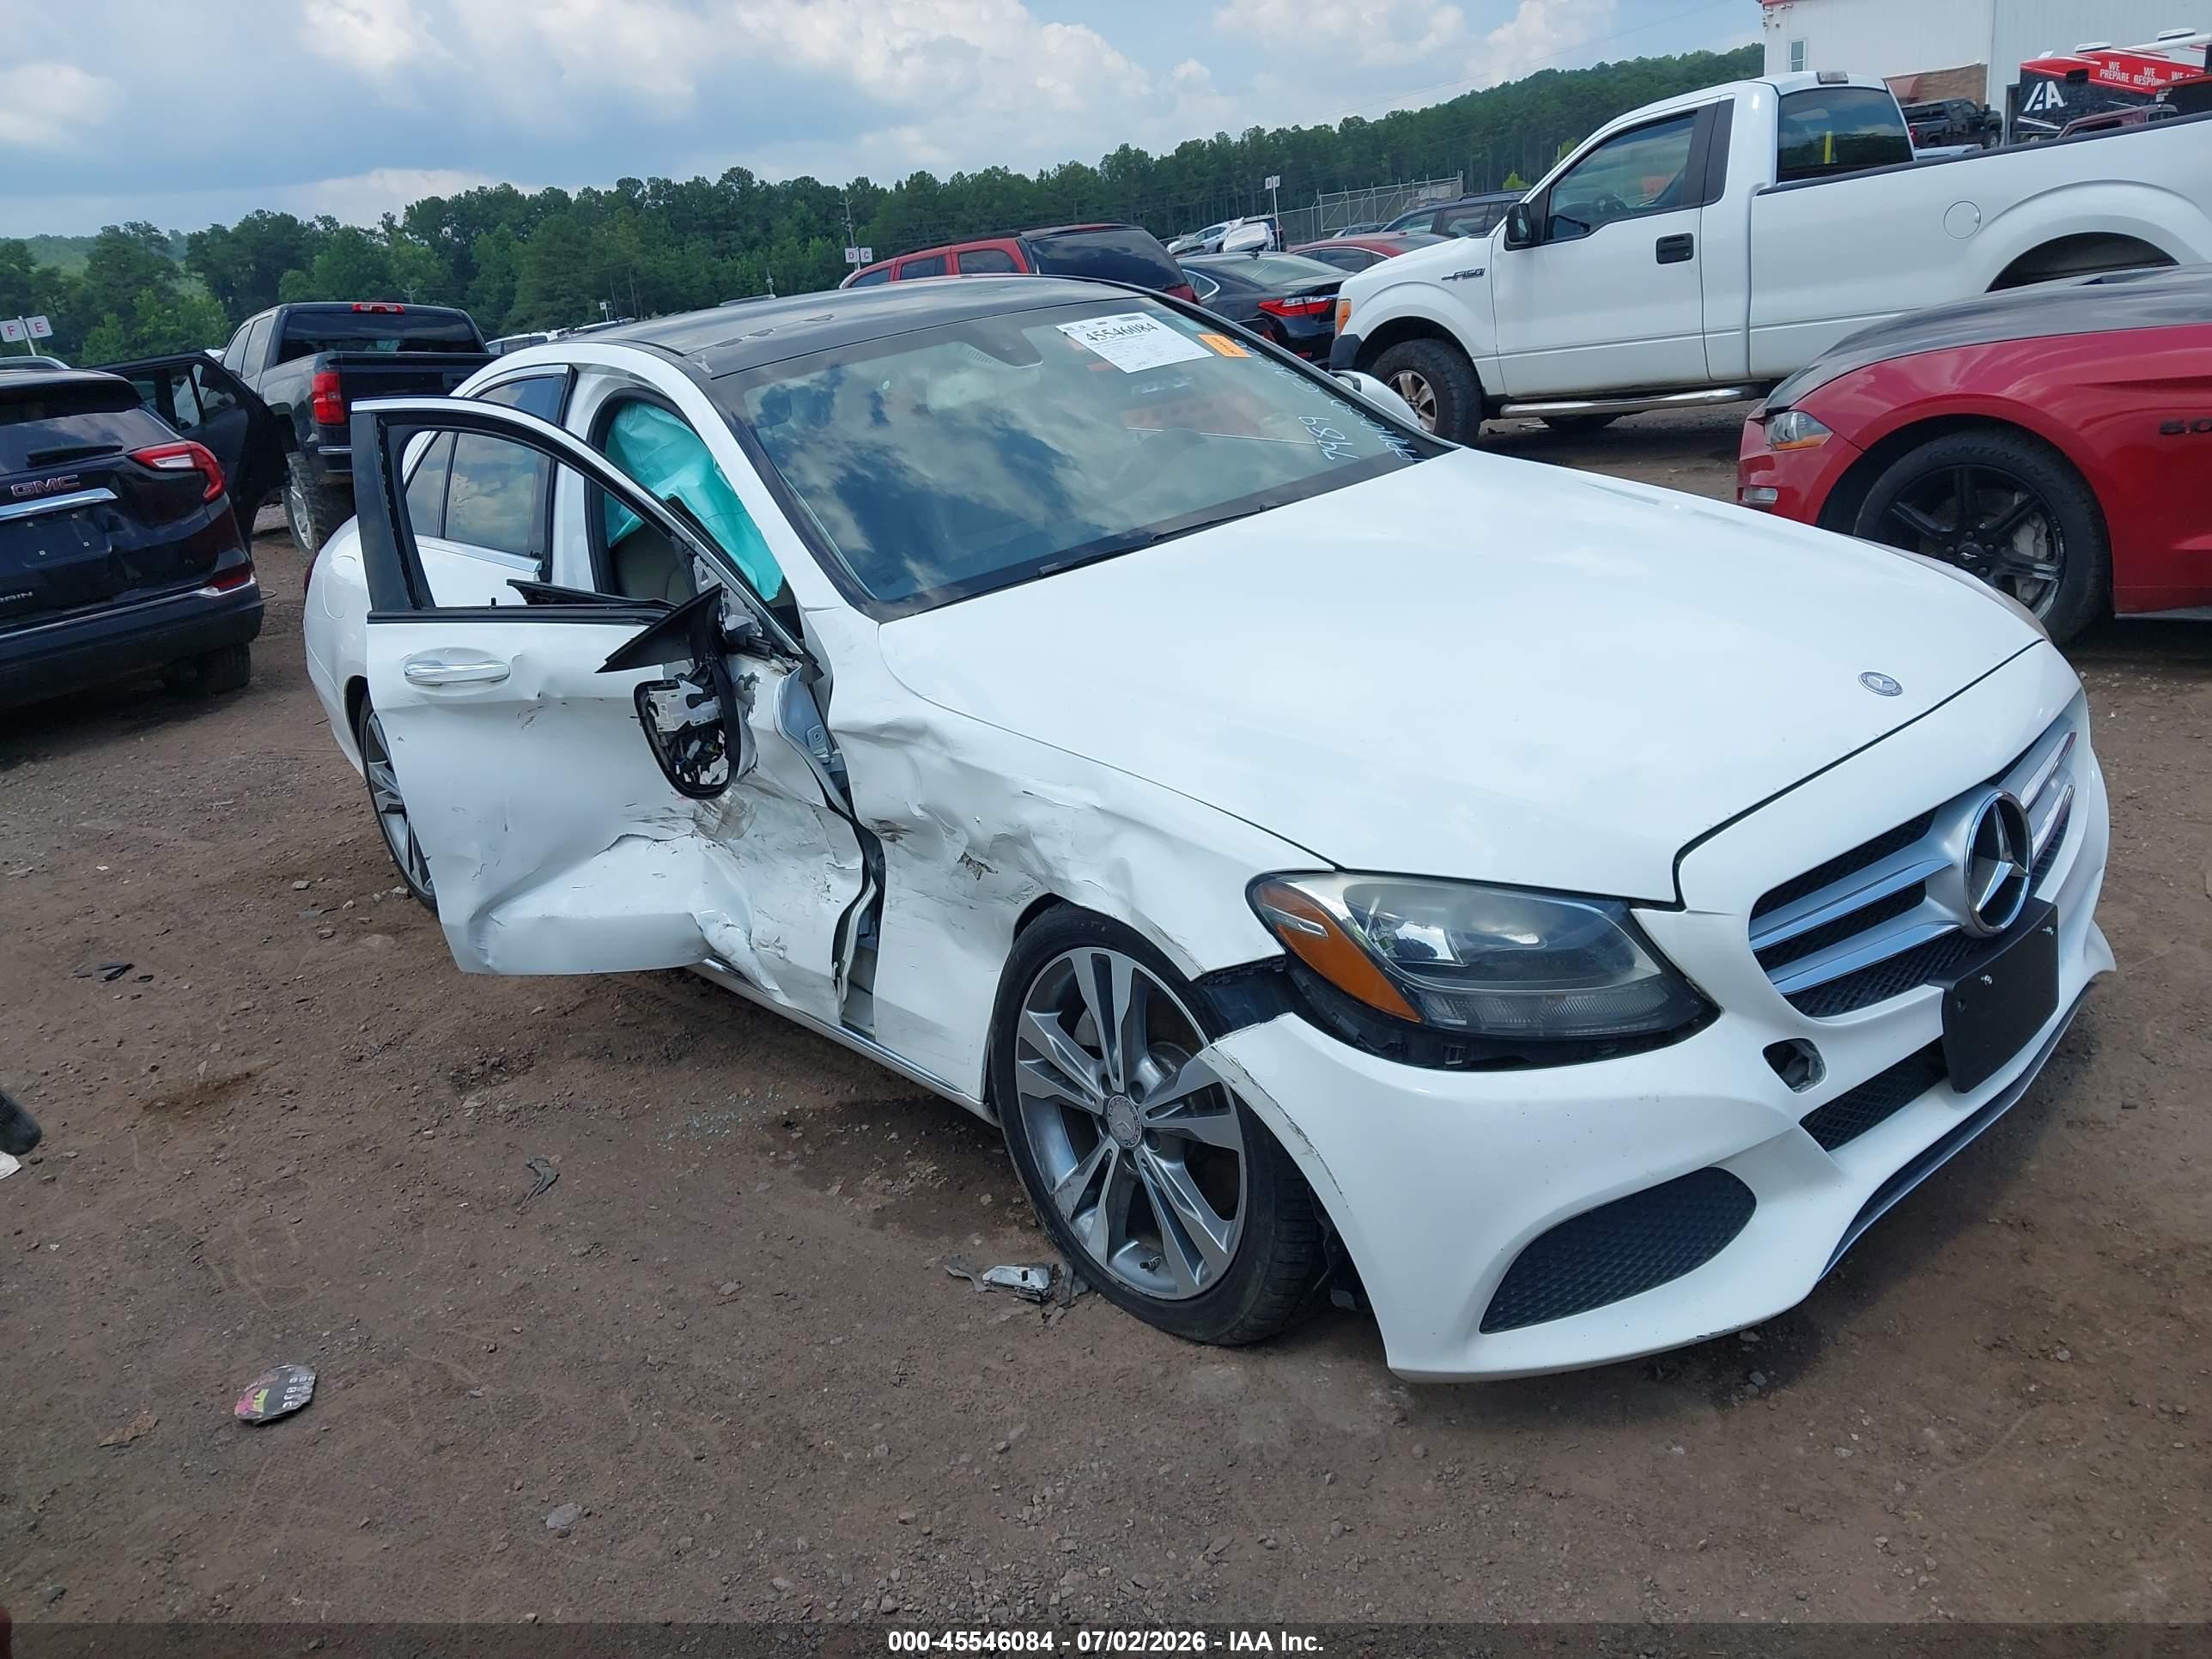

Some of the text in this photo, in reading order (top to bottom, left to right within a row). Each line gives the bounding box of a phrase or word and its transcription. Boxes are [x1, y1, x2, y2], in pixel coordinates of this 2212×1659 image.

[2109, 61, 2120, 70] WE
[2100, 69, 2130, 83] PREPARE
[2143, 67, 2155, 77] WE
[6, 325, 15, 336] F
[33, 322, 45, 333] E
[1085, 322, 1159, 341] 45546084
[10, 474, 82, 497] GMC
